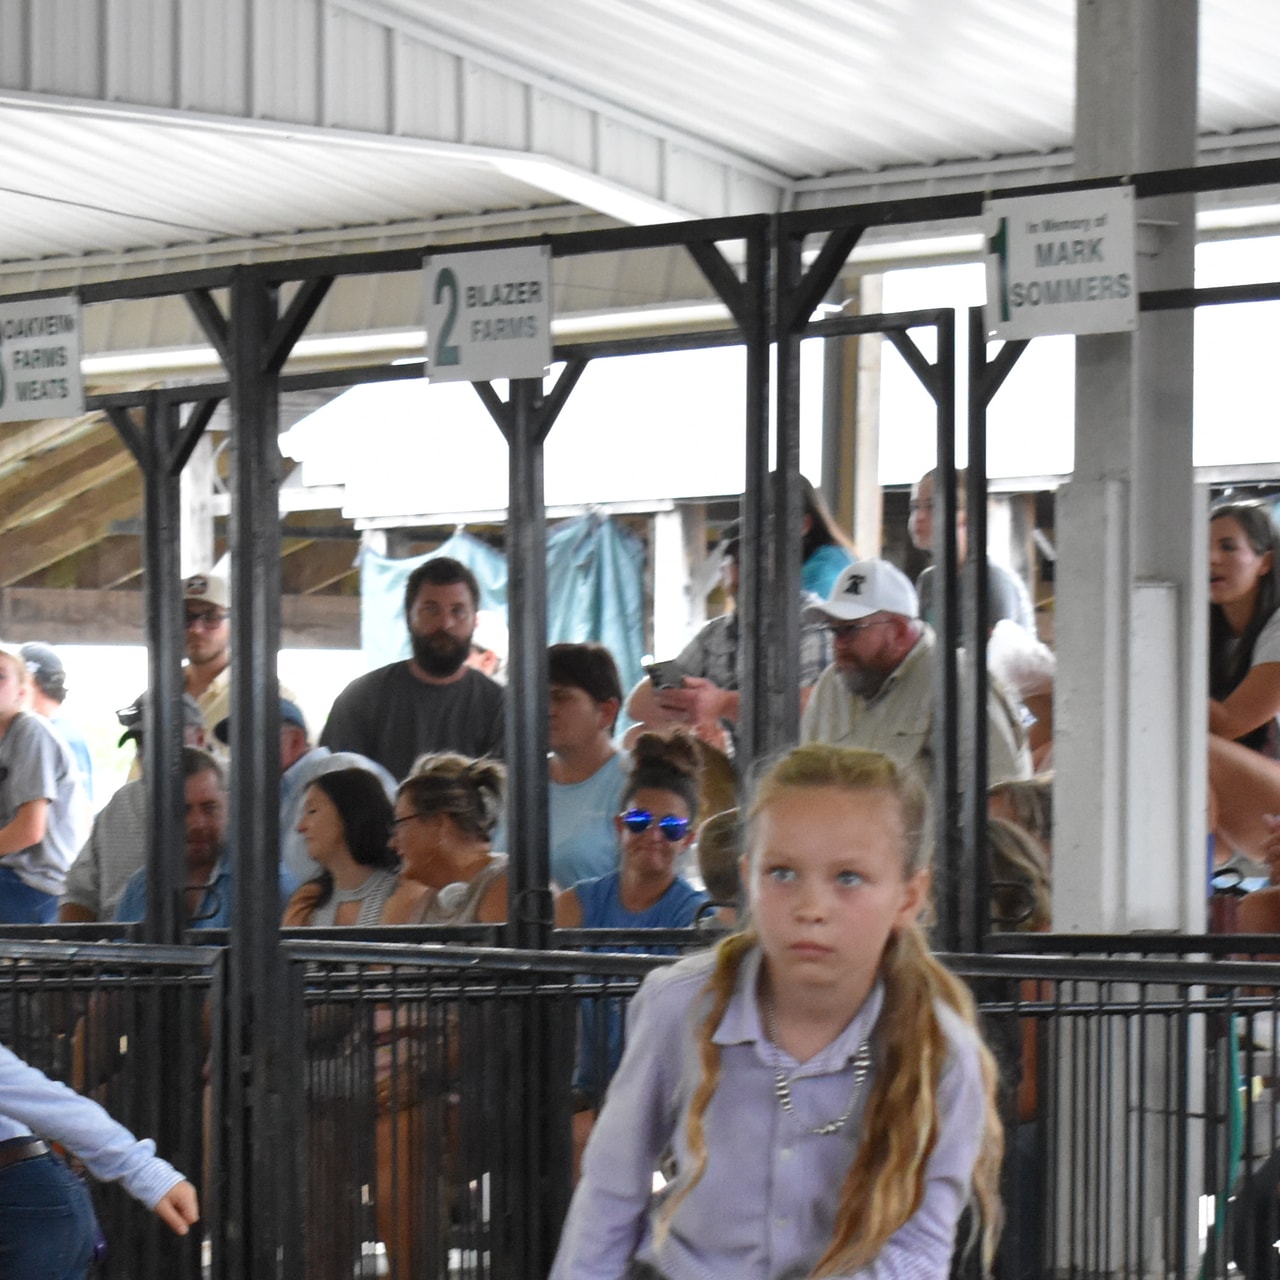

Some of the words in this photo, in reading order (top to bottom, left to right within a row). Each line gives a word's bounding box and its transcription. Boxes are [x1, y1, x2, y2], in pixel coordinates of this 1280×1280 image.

[1042, 218, 1091, 232] Memory
[1095, 213, 1108, 227] of
[1035, 237, 1105, 268] MARK
[989, 216, 1010, 322] 1
[466, 281, 542, 309] BLAZER
[1012, 273, 1131, 308] SOMMERS
[434, 267, 461, 367] 2
[472, 315, 537, 341] FARMS
[13, 347, 67, 370] FARMS
[16, 378, 69, 401] MEATS
